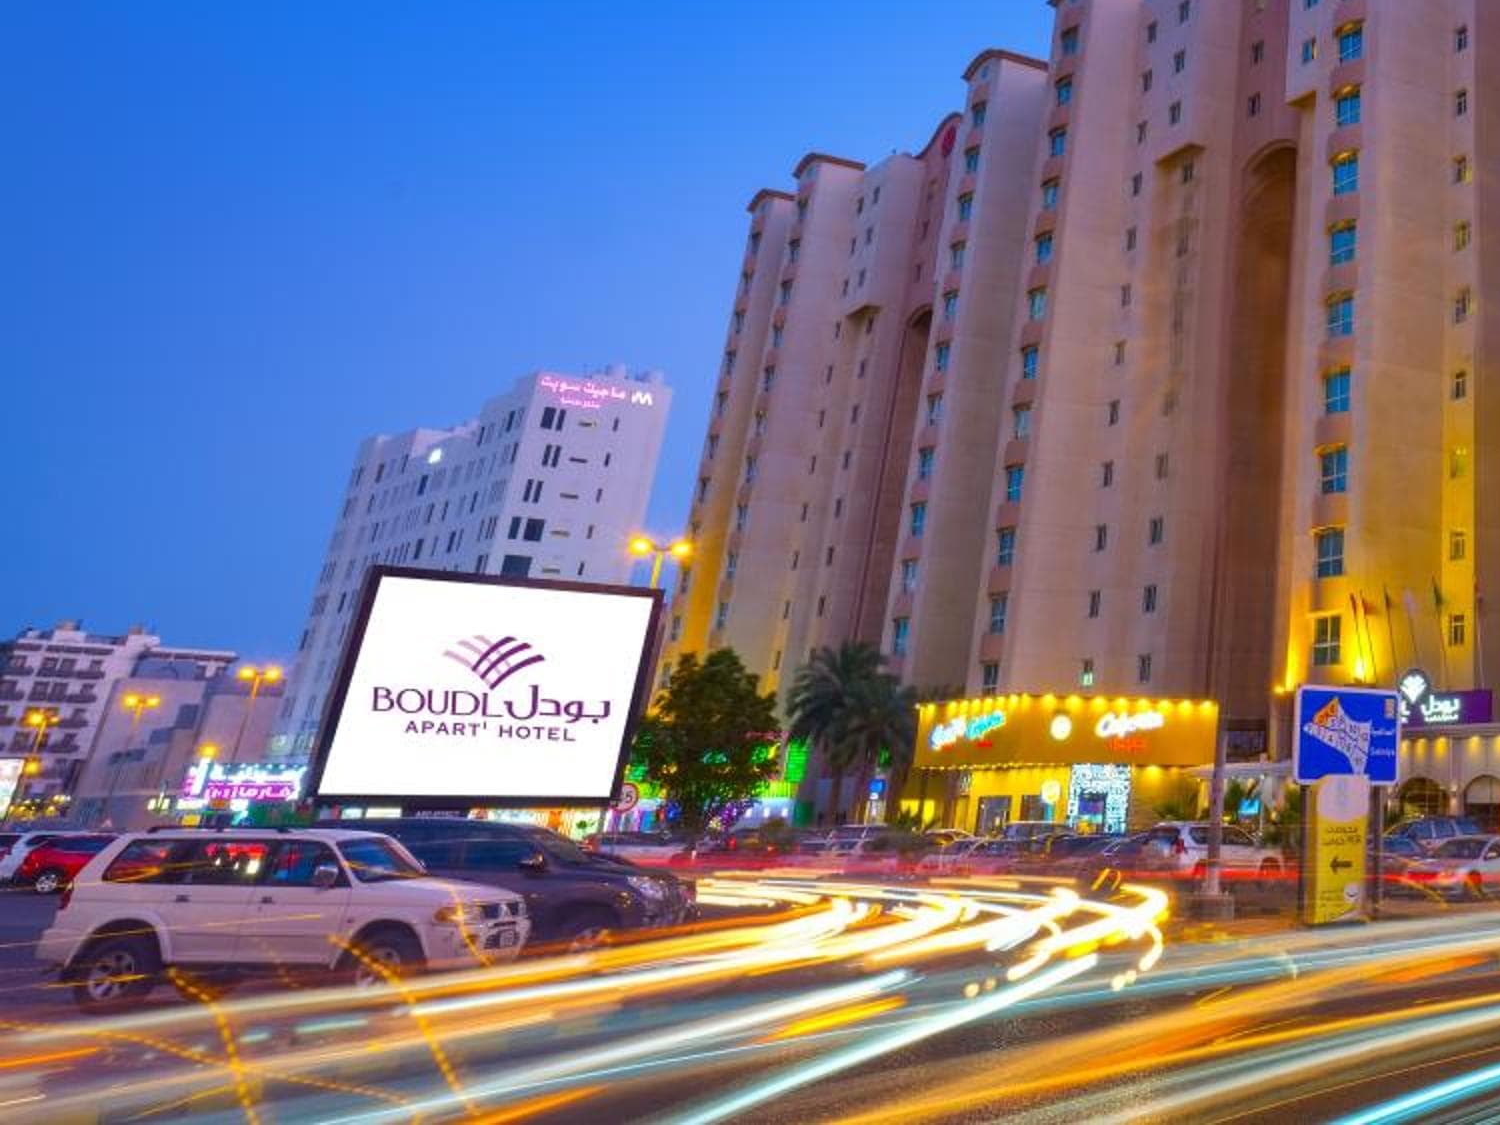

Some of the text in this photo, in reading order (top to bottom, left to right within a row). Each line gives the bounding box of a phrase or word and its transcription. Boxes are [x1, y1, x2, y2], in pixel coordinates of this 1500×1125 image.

[371, 686, 504, 718] BOUDL
[504, 684, 612, 724] بودل
[499, 725, 576, 742] HOTEL
